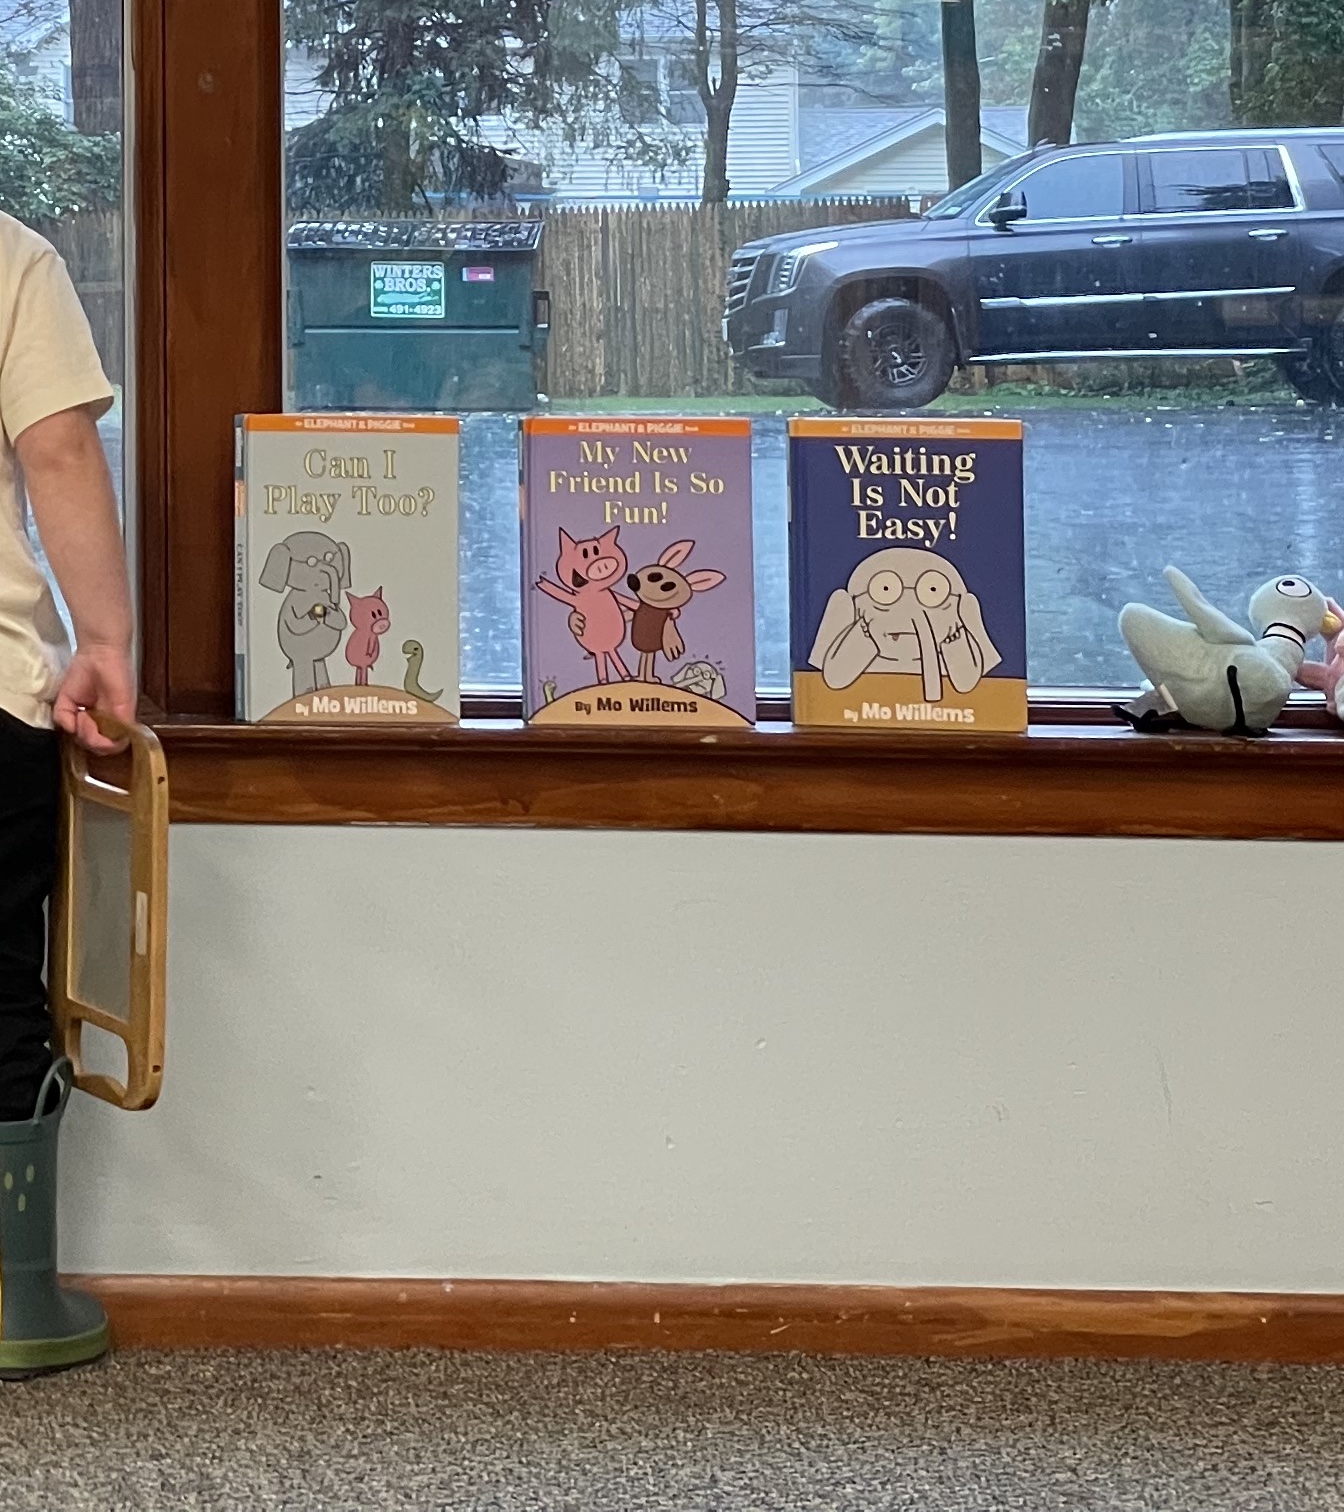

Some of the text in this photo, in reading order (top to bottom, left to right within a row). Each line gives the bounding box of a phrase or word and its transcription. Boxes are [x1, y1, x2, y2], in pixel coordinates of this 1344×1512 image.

[373, 264, 443, 279] WINTERS
[383, 277, 431, 292] BROS.
[303, 418, 357, 430] ELEPHANT
[358, 420, 366, 430] &
[367, 419, 402, 430] PIGGIE
[578, 422, 636, 433] ELEPHANT
[637, 423, 645, 433] &
[647, 422, 685, 434] PIGGIE
[851, 423, 908, 435] ELEPHANT
[918, 424, 956, 436] PIGGIE
[303, 448, 397, 479] Can I
[579, 440, 692, 469] My New
[833, 445, 976, 483] Waiting
[549, 470, 724, 494] Friend Is So
[850, 477, 960, 507] Is Not
[263, 484, 341, 523] Play
[352, 485, 435, 517] Too?
[604, 501, 668, 524] Fun!
[857, 510, 957, 548] Easy!
[295, 696, 418, 716] By Mo Willems
[575, 697, 698, 715] By Mo Willems
[843, 702, 975, 723] By Mo Willems
